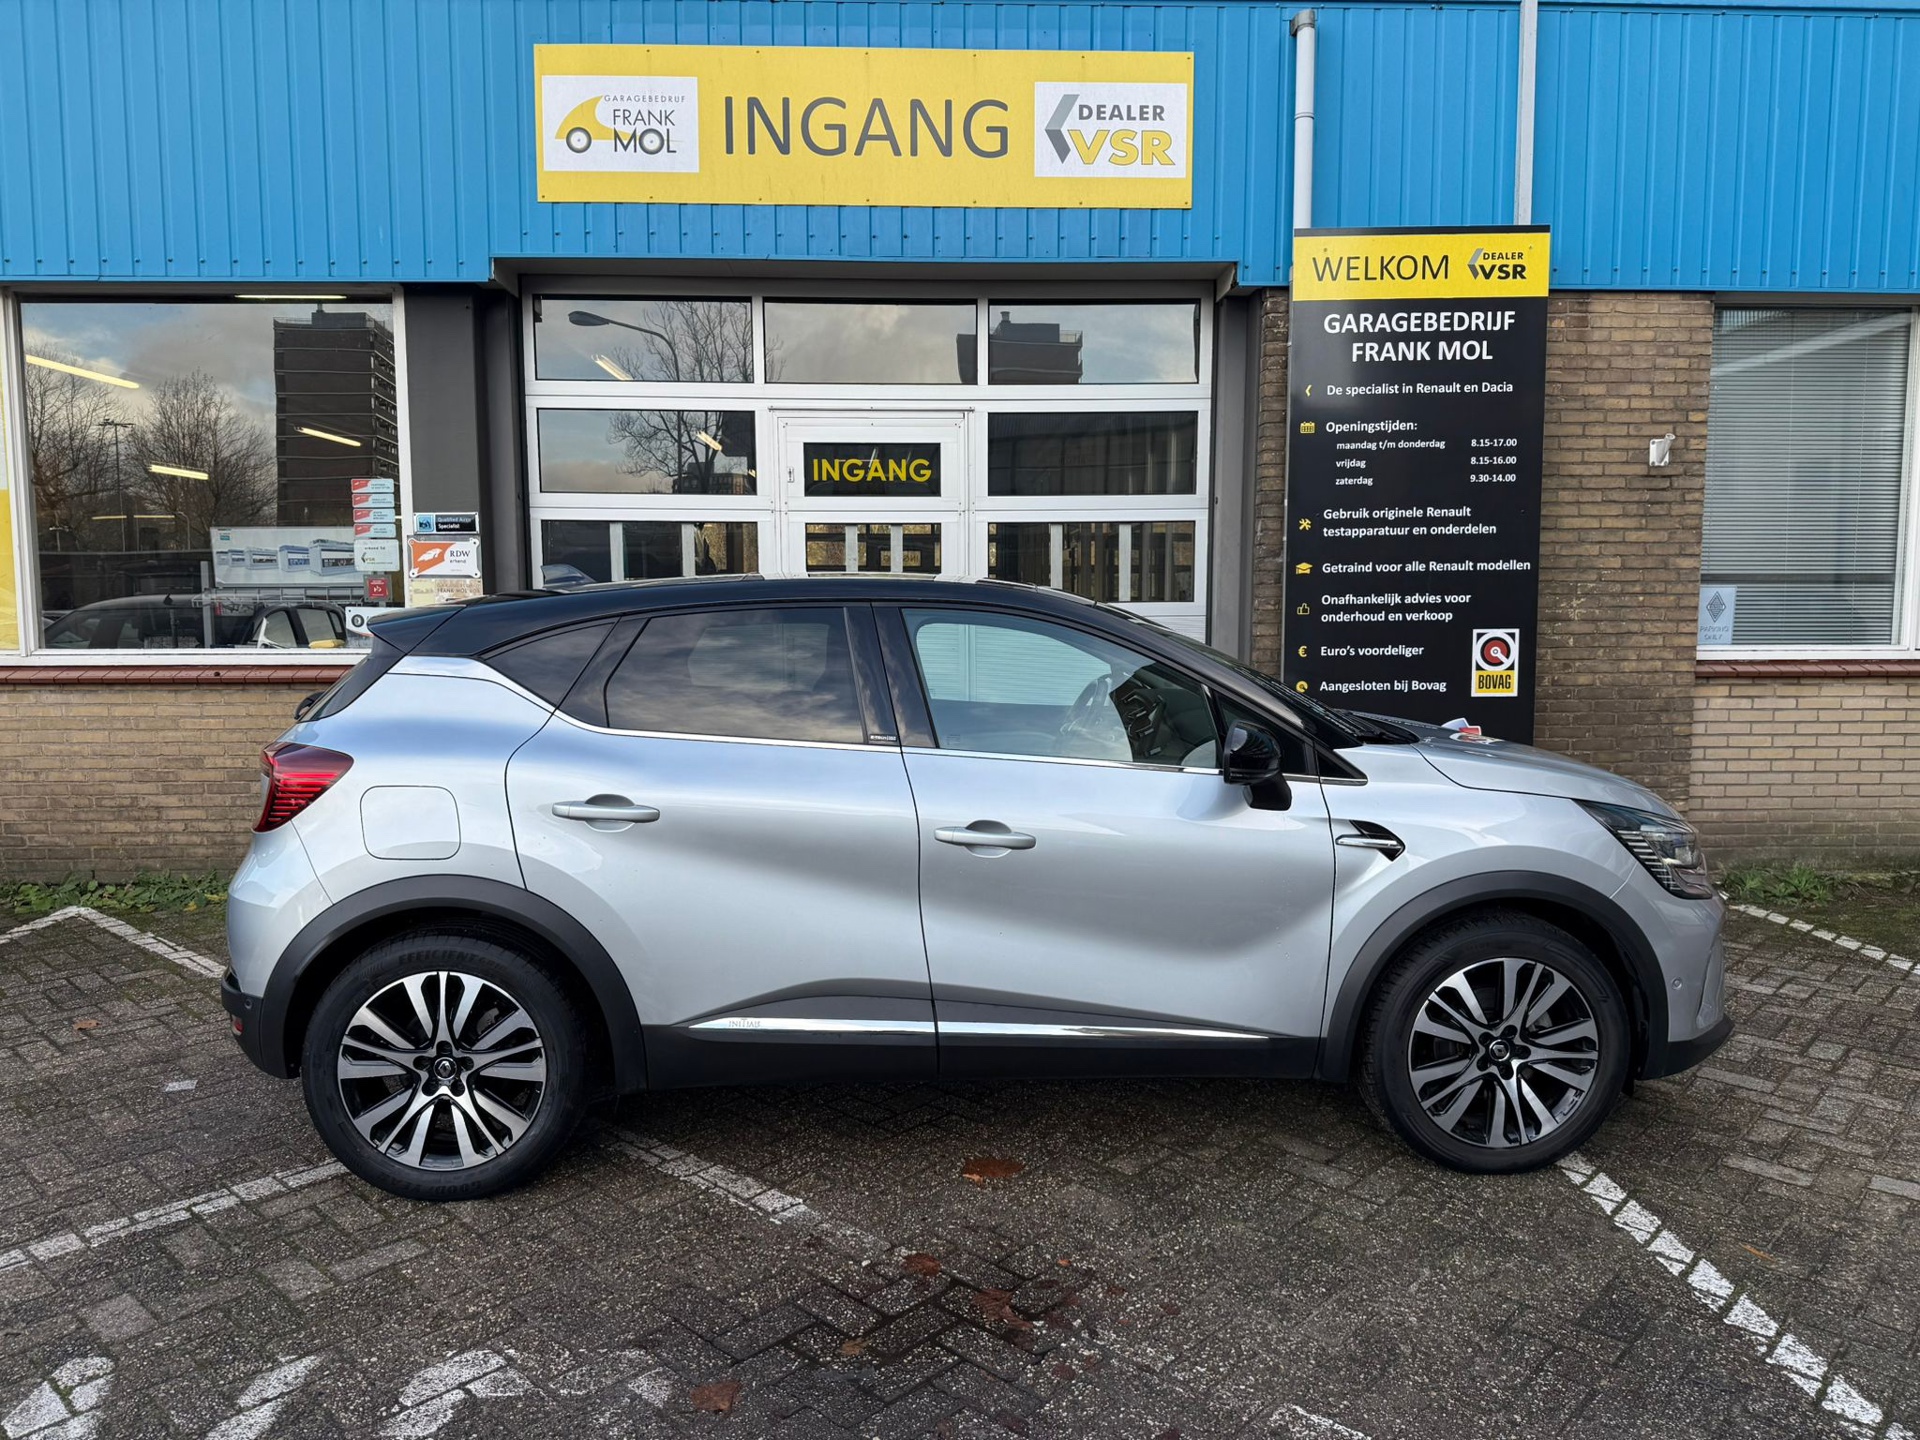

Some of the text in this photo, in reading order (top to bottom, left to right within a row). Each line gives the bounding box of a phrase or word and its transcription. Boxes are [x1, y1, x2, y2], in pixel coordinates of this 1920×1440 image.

[613, 109, 675, 126] FRANK
[1079, 104, 1165, 121] DEALER
[724, 95, 1009, 158] INGANG
[614, 128, 677, 155] MOL
[1067, 129, 1175, 166] VSR
[1483, 252, 1523, 260] DEALER
[1312, 255, 1449, 281] WELKOM
[1480, 264, 1527, 280] VSR
[1324, 311, 1515, 334] GARAGEBEDRIJF
[1352, 341, 1493, 362] FRANK MOL
[1327, 382, 1513, 398] De specialist in Renault en Dacia
[1326, 421, 1417, 433] Openingstijden:
[1337, 439, 1517, 450] maandag t/m donderdag 8.15-17.00
[813, 459, 931, 482] INGANG
[1336, 459, 1366, 468] vrijdag
[1336, 474, 1516, 486] zaterdag 9.30-14.00
[1324, 506, 1471, 520] Gebruik originele Renault
[1323, 524, 1496, 538] testapparatuur en onderdelen
[1322, 560, 1530, 573] Getraind voor alle Renault modellen
[1322, 594, 1471, 606] Onafhankelijk advies voor
[1321, 611, 1453, 622] onderhoud en verkoop
[1358, 645, 1424, 658] voordeliger
[1320, 680, 1446, 693] Aangesloten bij Bovag
[1478, 675, 1511, 689] BOVAG
